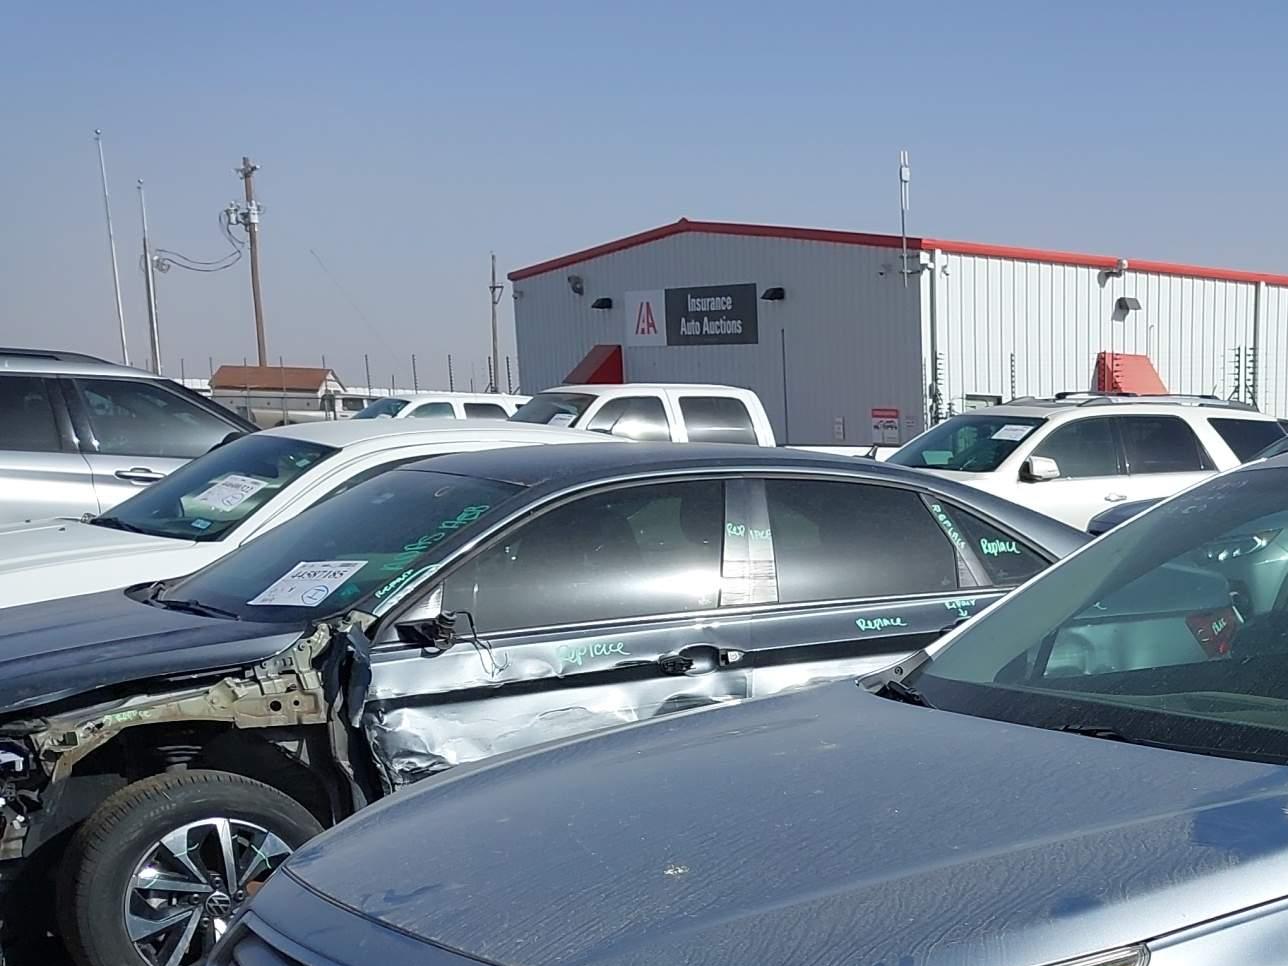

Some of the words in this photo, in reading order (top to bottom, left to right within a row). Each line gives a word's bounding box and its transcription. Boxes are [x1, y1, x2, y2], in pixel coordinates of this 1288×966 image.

[688, 293, 733, 312] Insurance
[680, 317, 700, 335] Auto
[703, 315, 742, 334] Auctions
